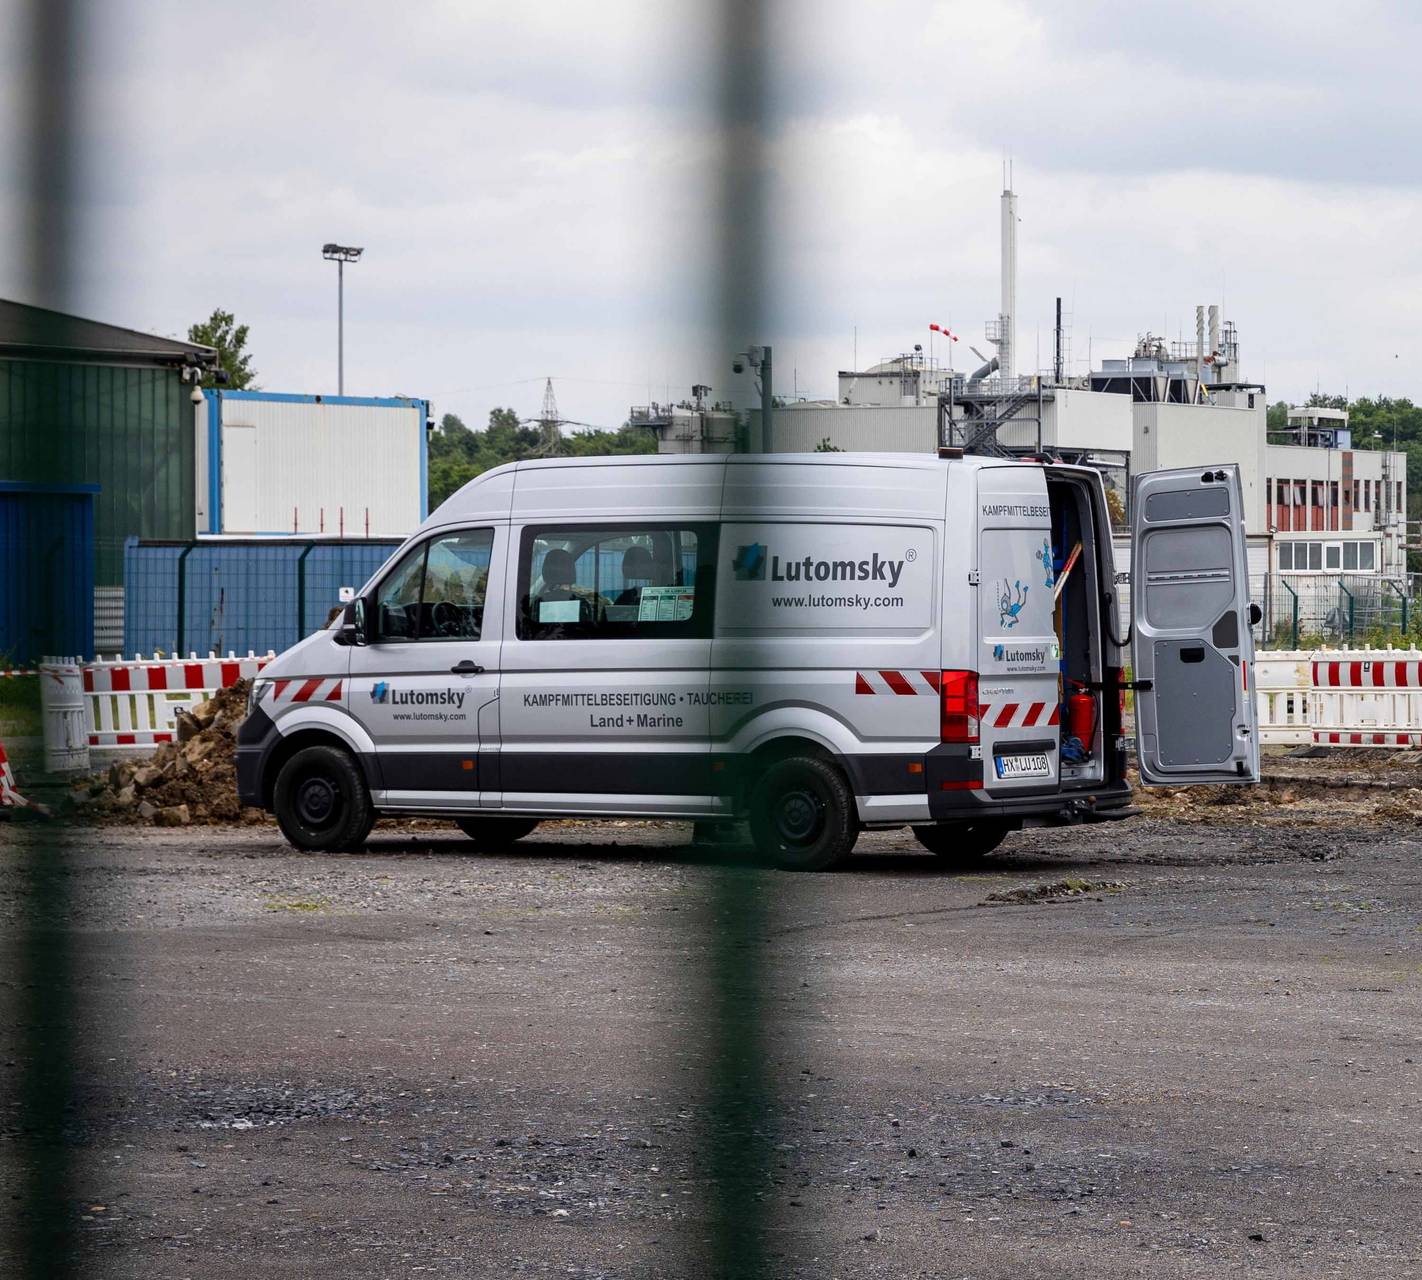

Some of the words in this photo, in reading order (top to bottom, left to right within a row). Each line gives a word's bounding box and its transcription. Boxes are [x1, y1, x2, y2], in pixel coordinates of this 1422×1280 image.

[772, 594, 904, 610] www.lutomsky.com
[1005, 648, 1045, 663] Lutomsky
[523, 692, 676, 706] KAMPFMITTELBESEITIGUNG
[687, 691, 754, 706] TAUCHEREI
[393, 712, 466, 722] www.lutomsky.com
[1003, 758, 1016, 772] HX
[1020, 758, 1032, 771] LU
[1032, 756, 1047, 771] 108
